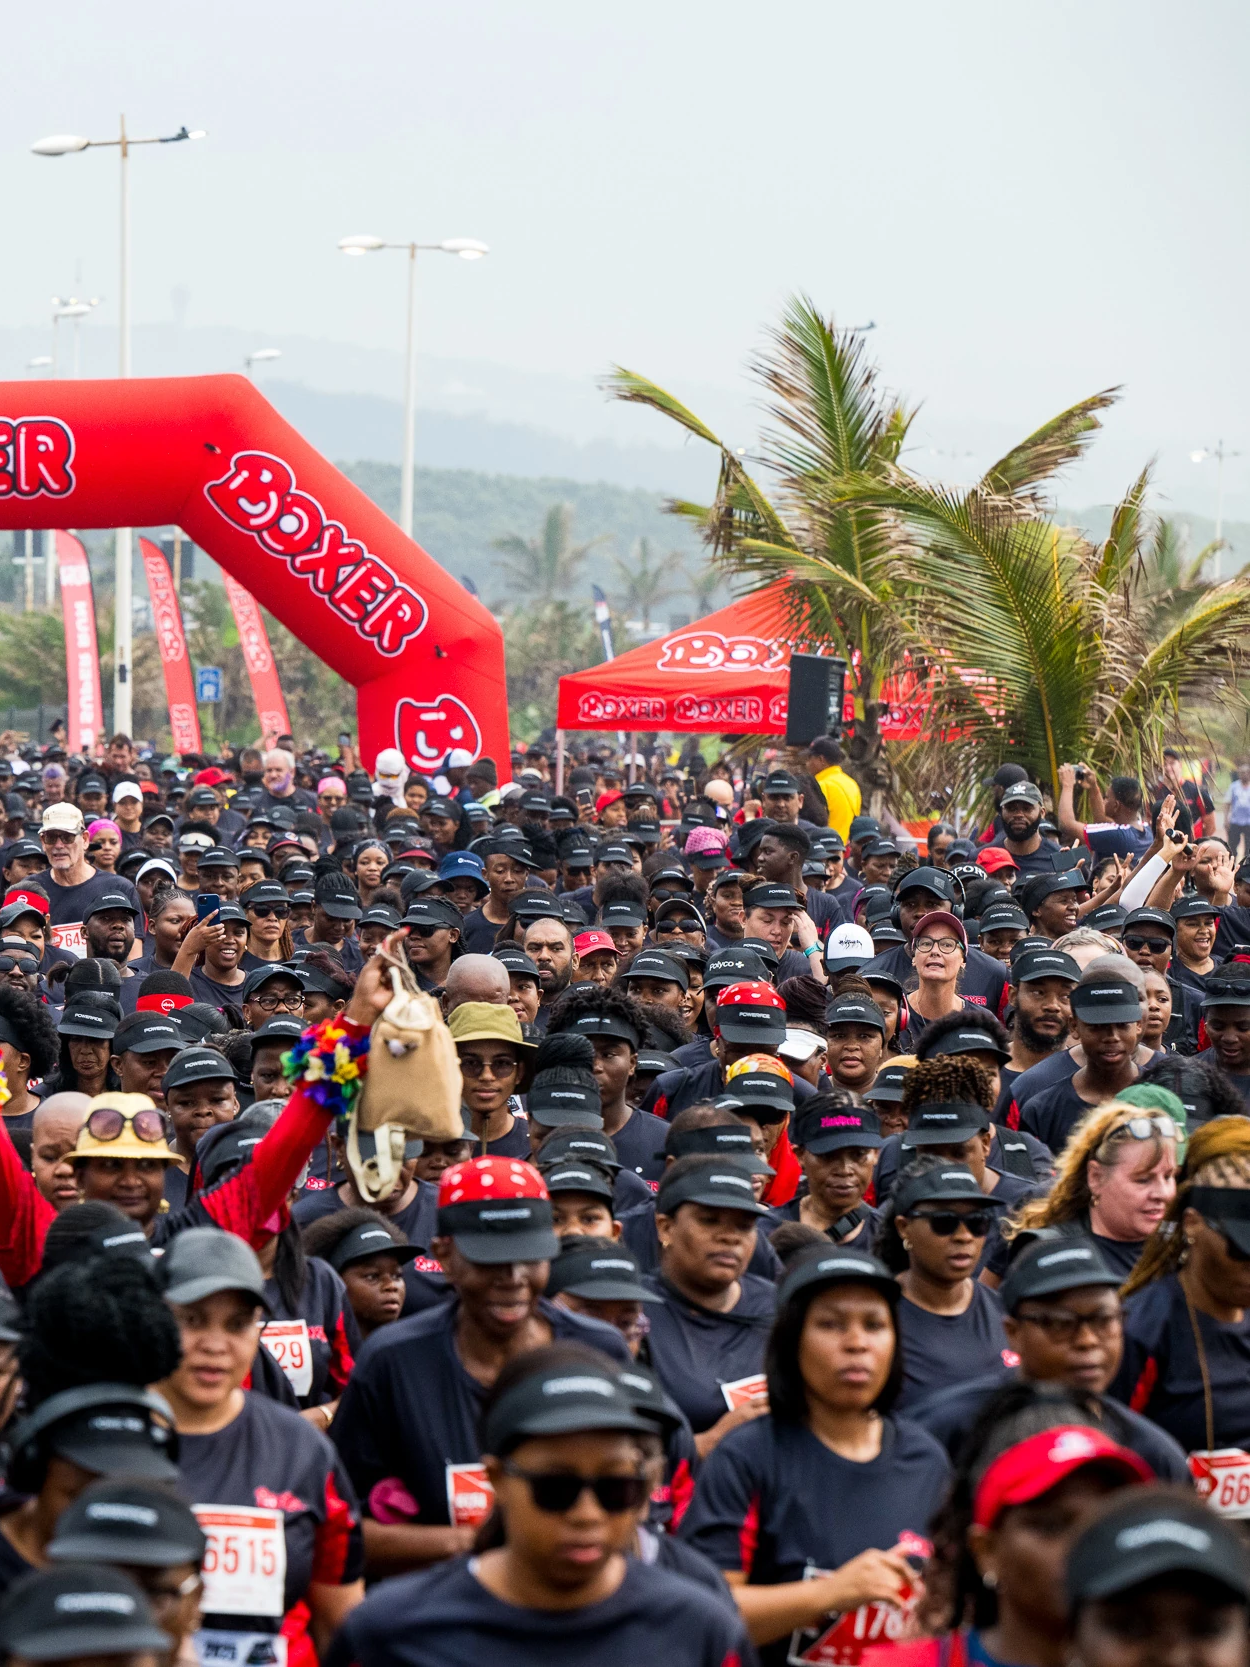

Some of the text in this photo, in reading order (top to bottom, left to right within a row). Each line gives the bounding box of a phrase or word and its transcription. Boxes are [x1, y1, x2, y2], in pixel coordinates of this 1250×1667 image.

[203, 449, 429, 658] BOXER
[578, 691, 667, 724] BOXER
[674, 693, 764, 725] BOXER
[74, 1012, 104, 1023] POWERADE
[739, 1011, 771, 1019] POWERADE
[184, 1059, 218, 1069] POWERADE
[742, 1079, 777, 1088] POWERADE
[264, 1341, 304, 1370] 29
[202, 1535, 277, 1577] 6515
